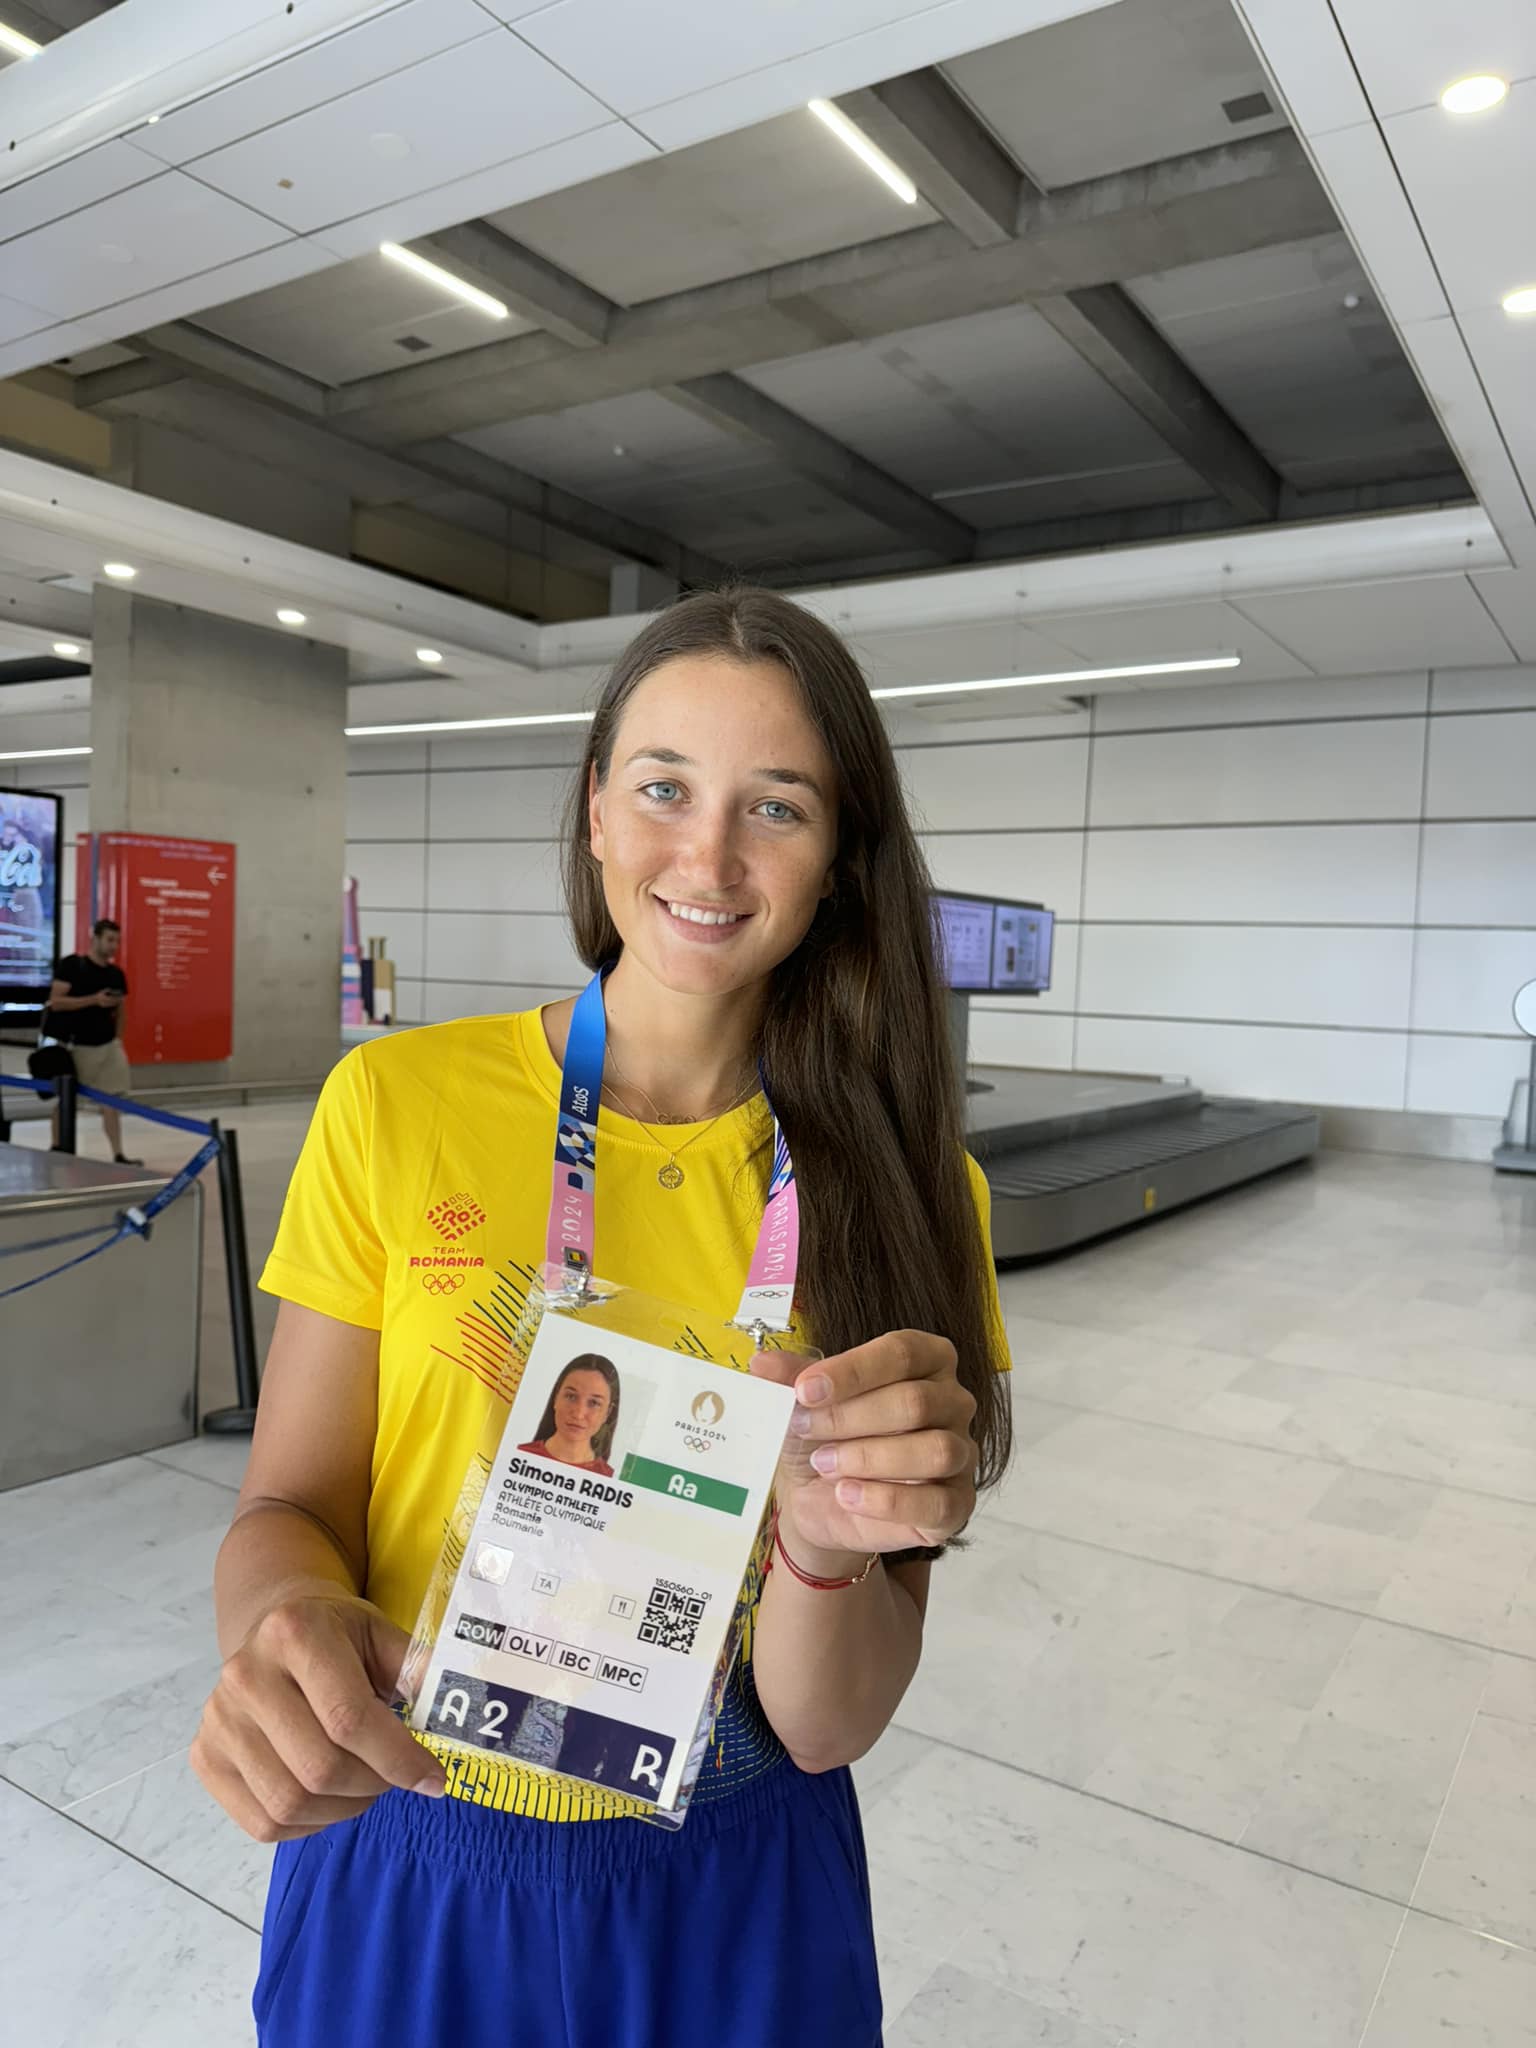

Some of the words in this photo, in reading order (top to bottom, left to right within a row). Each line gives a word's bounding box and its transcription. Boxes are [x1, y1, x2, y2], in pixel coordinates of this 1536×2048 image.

[562, 1196, 583, 1243] 2024
[769, 1195, 788, 1242] PARIS
[409, 1256, 485, 1268] ROMANIA
[432, 1246, 466, 1255] TEAM
[762, 1242, 787, 1281] 2024
[674, 1420, 701, 1434] PARIS
[702, 1429, 728, 1441] 2024
[503, 1478, 555, 1502] OLYMPIC
[554, 1494, 600, 1516] ATHLETE
[508, 1457, 576, 1492] Simona
[578, 1478, 634, 1509] RADIS
[667, 1473, 698, 1500] Aa
[491, 1512, 545, 1537] Roumanie
[495, 1502, 543, 1525] Romania
[498, 1490, 542, 1512] ATHLÈTE
[543, 1504, 607, 1532] OLYMPIQUE
[539, 1577, 553, 1590] TA
[456, 1619, 504, 1646] ROW
[509, 1635, 549, 1658] OLV
[558, 1650, 592, 1672] IBC
[600, 1663, 643, 1688] MPC
[438, 1688, 471, 1728] A
[477, 1701, 509, 1740] 2
[630, 1744, 663, 1787] R
